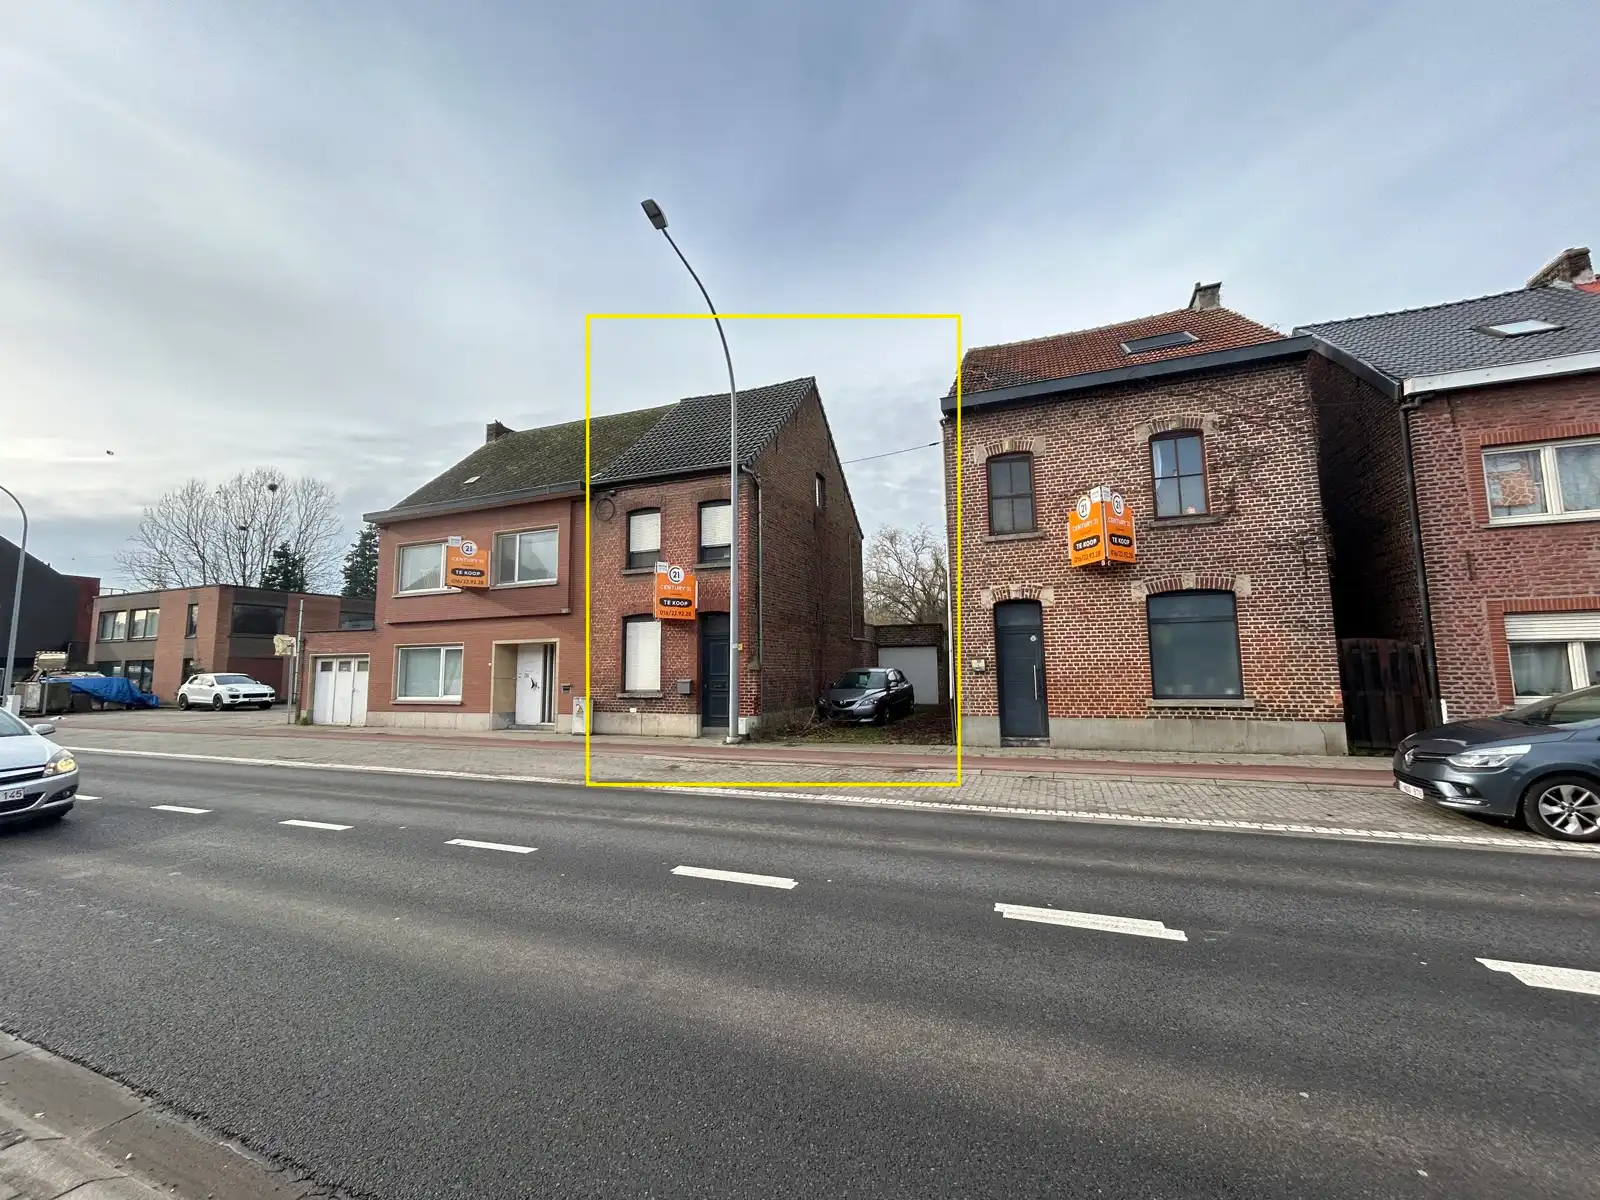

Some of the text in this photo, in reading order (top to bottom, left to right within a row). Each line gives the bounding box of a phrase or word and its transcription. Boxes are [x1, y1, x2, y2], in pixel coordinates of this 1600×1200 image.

[1072, 520, 1093, 531] CENTURY
[1108, 516, 1126, 526] CENTURY
[1083, 538, 1097, 548] KOOP
[1118, 537, 1130, 545] KOOP
[4, 789, 22, 800] 145
